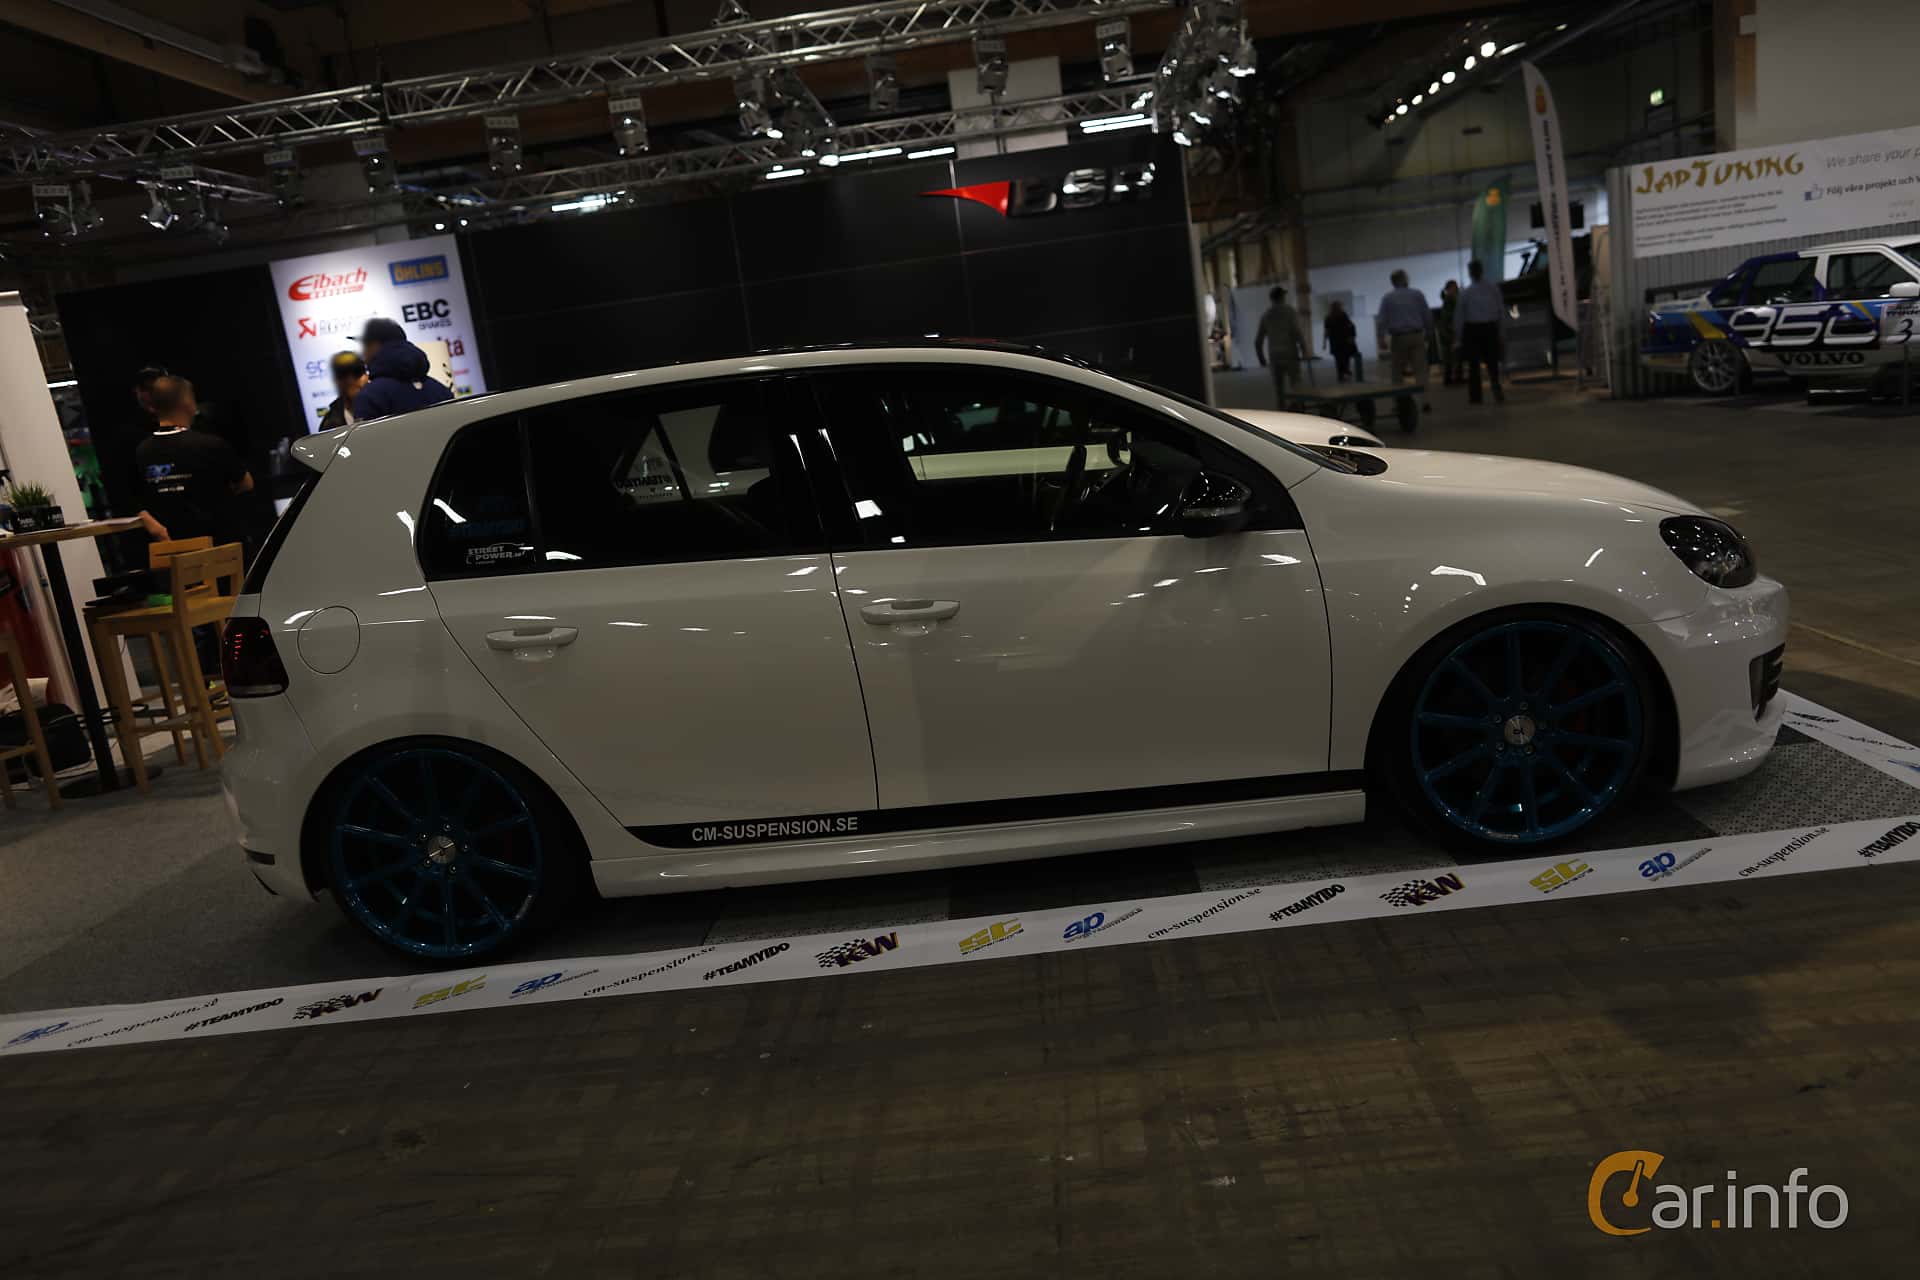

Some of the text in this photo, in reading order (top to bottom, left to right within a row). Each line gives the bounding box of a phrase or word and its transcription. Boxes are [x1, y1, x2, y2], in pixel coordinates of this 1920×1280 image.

[288, 266, 368, 301] Eibach
[402, 299, 450, 323] EBC
[1891, 318, 1914, 344] 3
[1777, 350, 1865, 366] VOLVO
[691, 816, 859, 842] CM-SUSPENSION.SE
[183, 998, 284, 1032] #TEAMYIDO
[583, 945, 716, 997] cm-suspension.se
[703, 942, 790, 981] #TEAMYIDO
[1063, 912, 1105, 939] ap
[1148, 888, 1262, 939] cm-suspension.se
[1269, 884, 1346, 921] #TEAMYIDO
[1638, 852, 1676, 877] ap
[1738, 826, 1830, 877] cm-suspension.se
